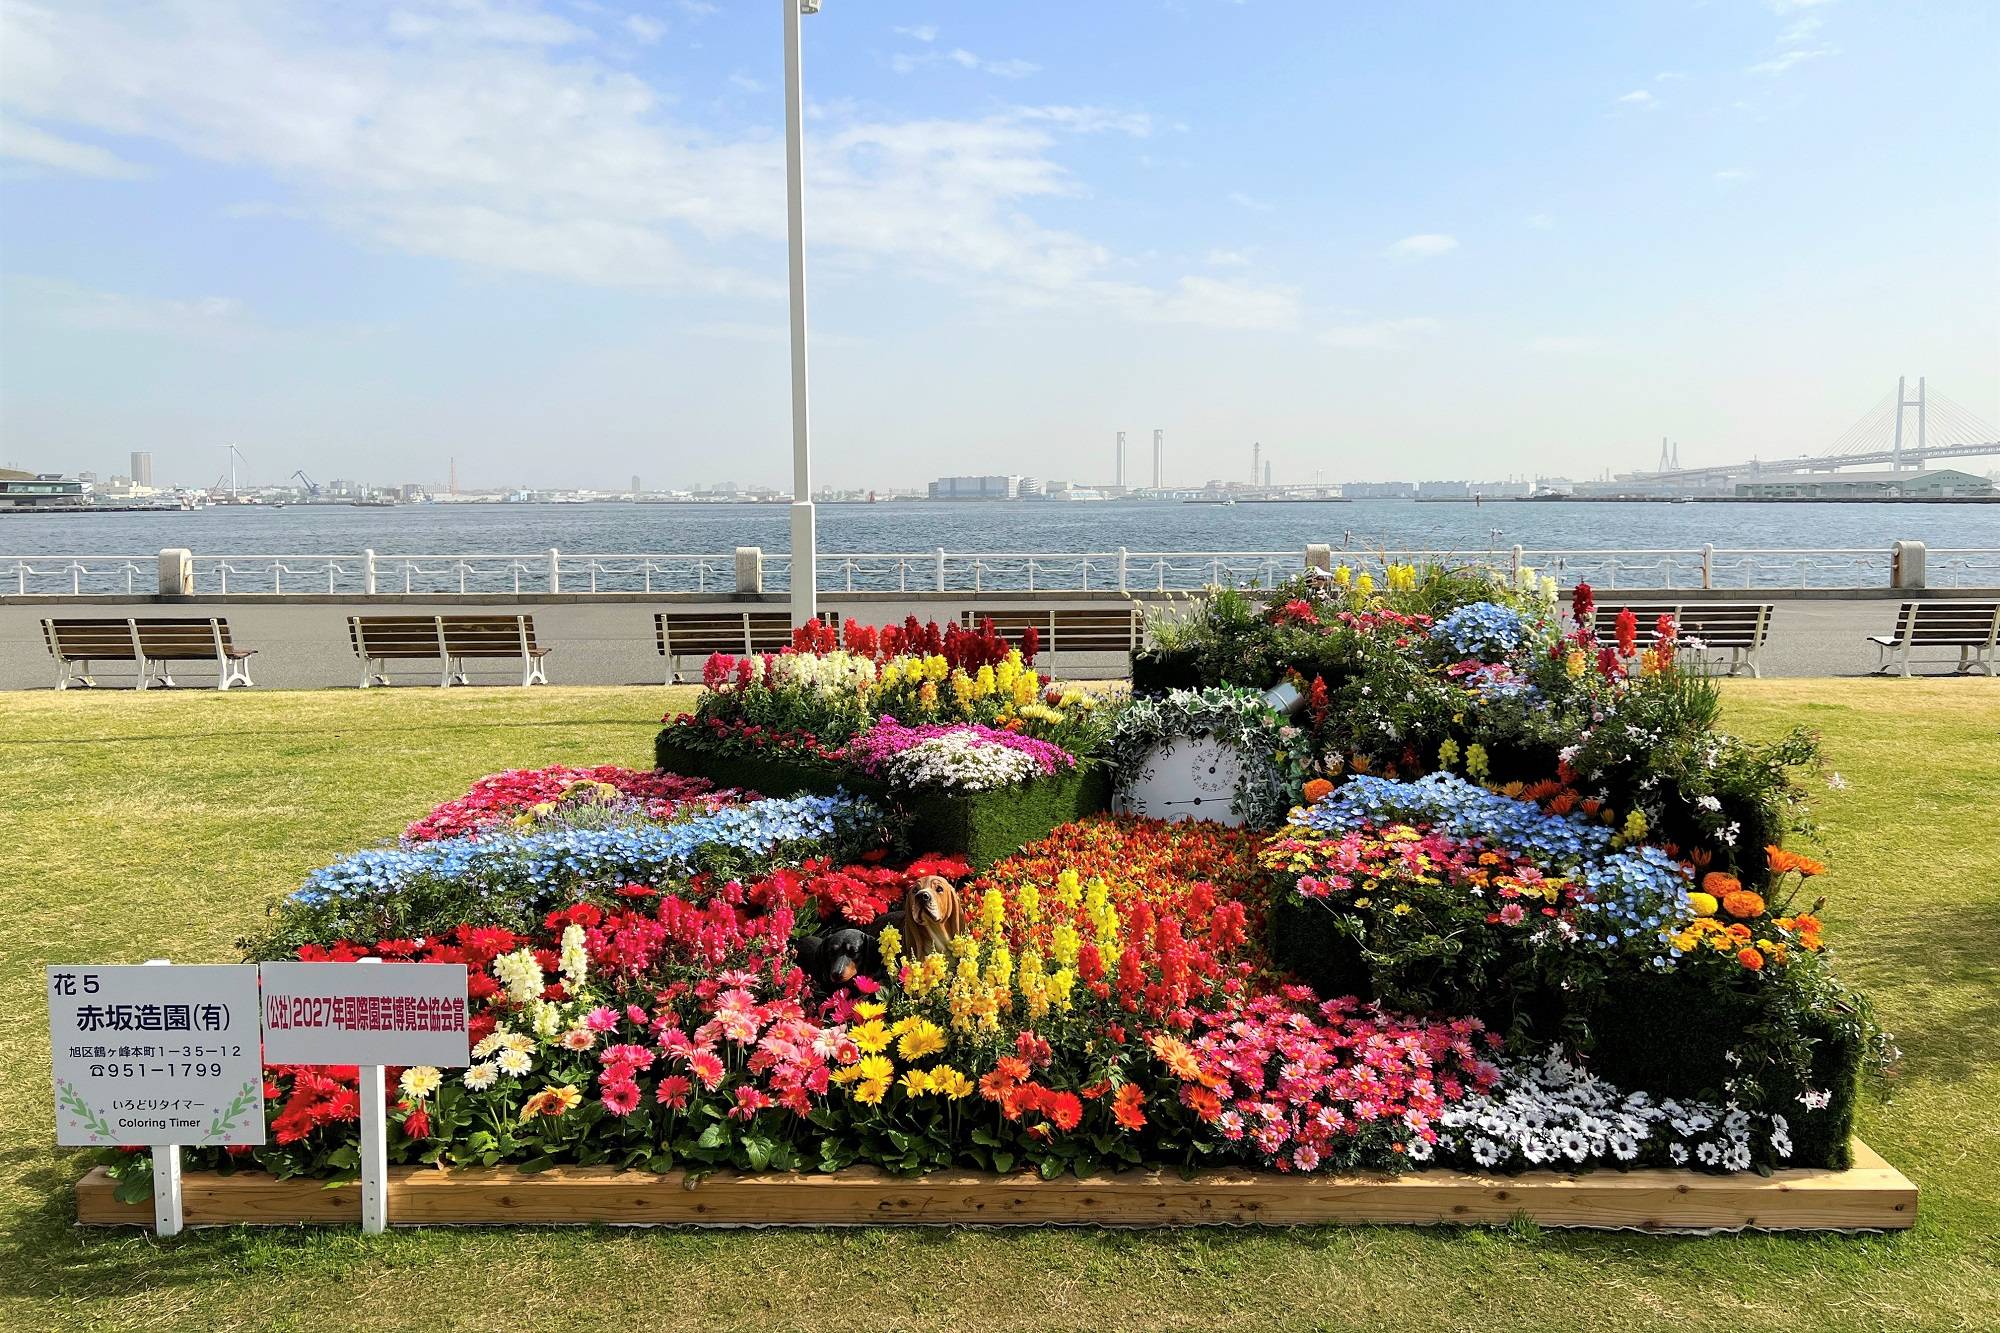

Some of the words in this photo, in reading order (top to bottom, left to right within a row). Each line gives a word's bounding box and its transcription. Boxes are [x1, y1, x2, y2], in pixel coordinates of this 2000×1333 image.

[1159, 745, 1176, 761] 50
[76, 1003, 230, 1032] 赤坂造園(有)
[266, 994, 466, 1033] (公社)2027年国際園芸博覧会協会賞
[112, 1099, 205, 1111] いろどりタイマー
[118, 1118, 166, 1129] Coloring
[169, 1118, 201, 1128] Timer
